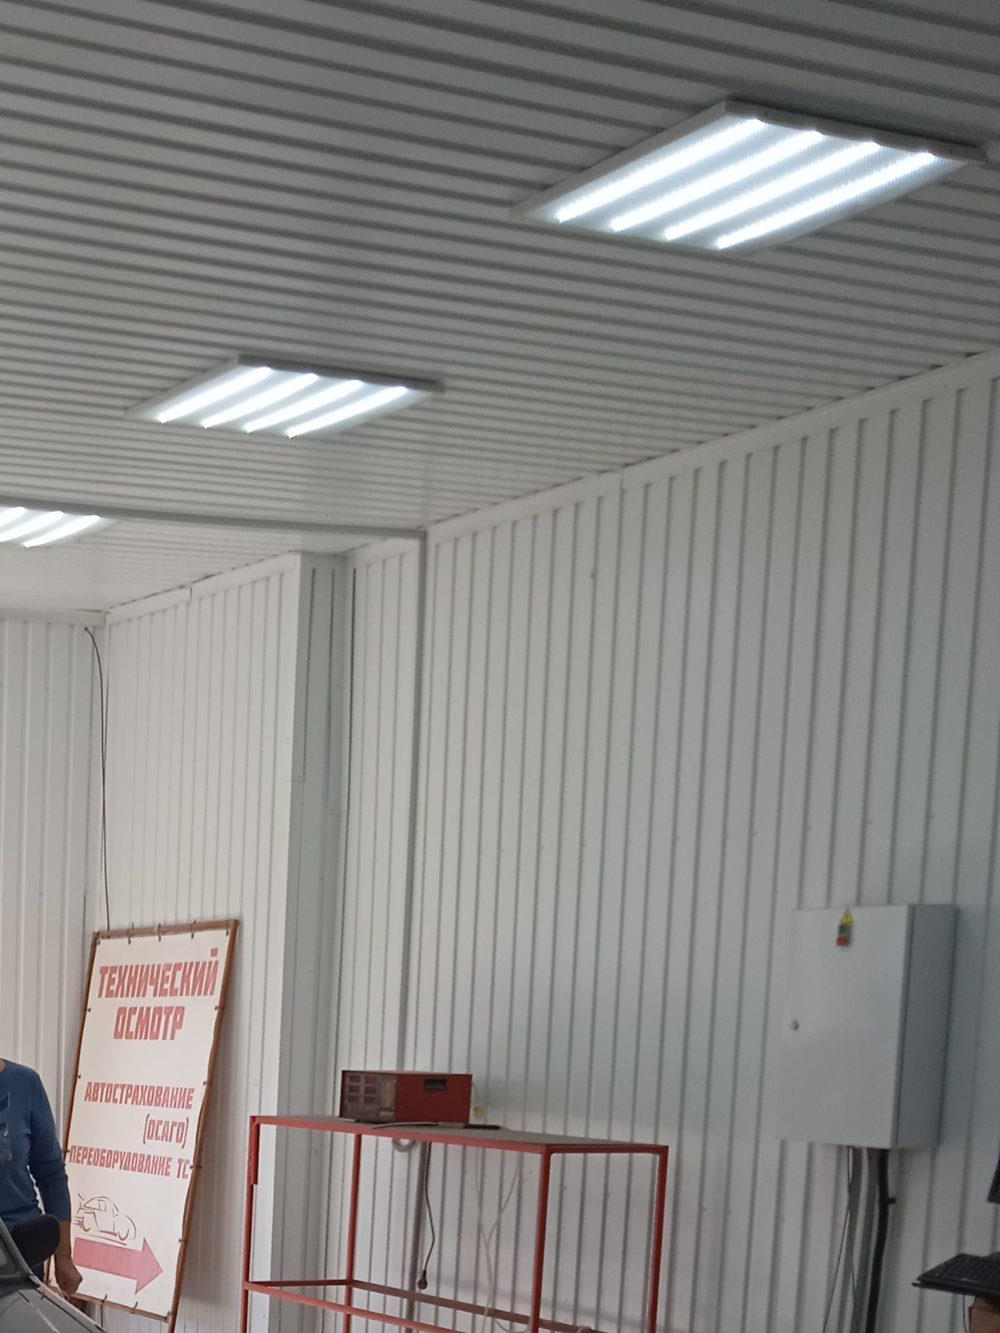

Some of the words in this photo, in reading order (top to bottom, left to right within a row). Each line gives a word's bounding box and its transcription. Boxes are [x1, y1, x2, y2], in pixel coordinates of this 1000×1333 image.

[98, 948, 219, 998] ТЕХНИЧЕСКИЙ
[113, 1006, 185, 1040] ОСМОТР
[84, 1081, 194, 1109] АВТОСТРАХОВАНИЕ
[143, 1113, 189, 1149] (ОСАГО)
[69, 1145, 172, 1177] ПЕРЕОБОРУДОВАНИЕ
[176, 1158, 190, 1179] ТС
